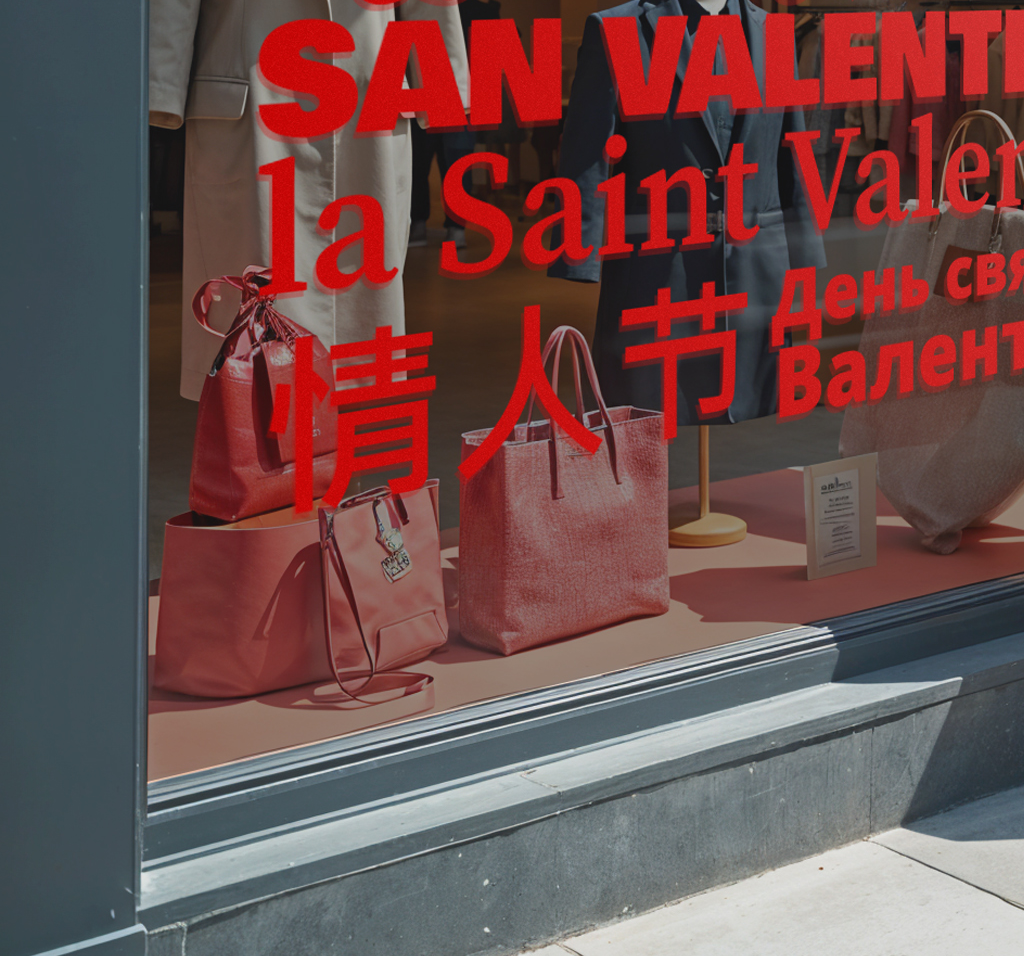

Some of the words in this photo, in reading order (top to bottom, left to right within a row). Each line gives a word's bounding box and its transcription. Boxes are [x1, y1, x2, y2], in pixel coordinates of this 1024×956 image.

[257, 18, 562, 138] SAN
[257, 156, 400, 297] la
[440, 133, 761, 275] Saint
[770, 264, 931, 347] День
[269, 280, 749, 515] 情人节
